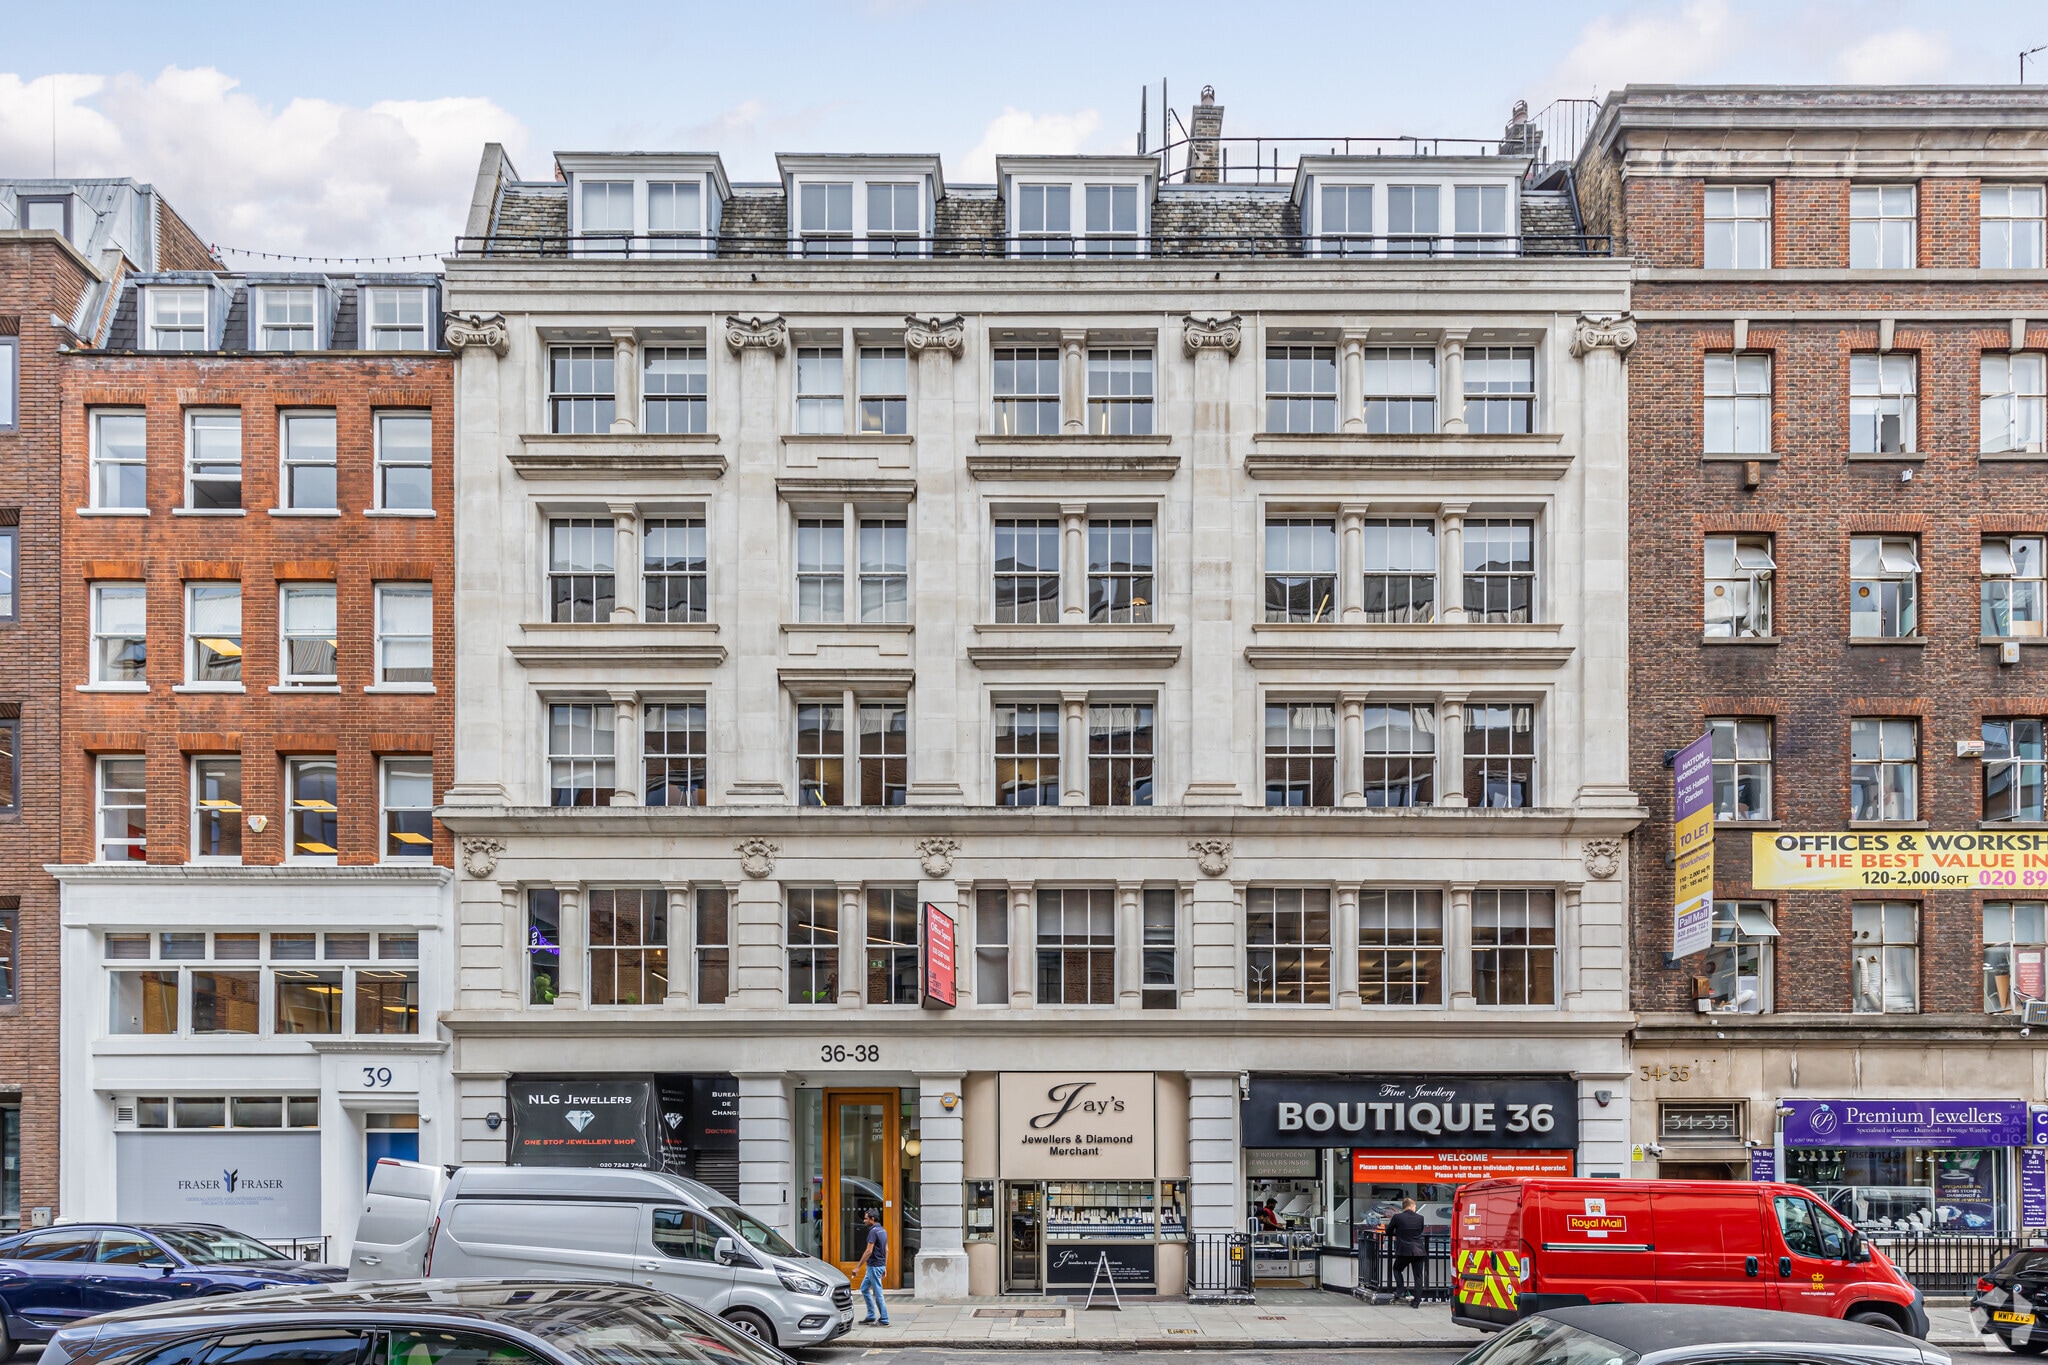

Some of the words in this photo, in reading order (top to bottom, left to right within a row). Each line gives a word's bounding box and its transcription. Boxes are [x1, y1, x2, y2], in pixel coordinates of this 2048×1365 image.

[1677, 756, 1711, 783] WORKSHOPS
[1682, 751, 1704, 771] HATTON
[1692, 774, 1710, 790] Hatton
[1684, 788, 1704, 804] Garden
[1680, 833, 1692, 847] TO
[1694, 822, 1710, 840] LET
[1775, 835, 1889, 851] OFFICES
[1896, 835, 1917, 851] &
[1925, 835, 2048, 850] WORKSH
[1679, 851, 1710, 870] Workshops
[1801, 854, 1853, 868] THE
[1861, 854, 1924, 868] BEST
[1932, 854, 2015, 867] VALUE
[2023, 854, 2048, 867] IN
[1862, 870, 1940, 885] 120-2,000
[1941, 875, 1955, 885] SQ
[1957, 875, 1968, 884] FT
[1979, 870, 2016, 886] 020
[2023, 870, 2047, 886] 89
[1680, 913, 1692, 928] Pall
[1692, 907, 1708, 923] Mall
[821, 1044, 879, 1062] 36-38
[363, 1067, 392, 1087] 39
[1640, 1064, 1690, 1082] 34-35
[528, 1094, 560, 1105] NLG
[1379, 1083, 1405, 1097] Fine
[1408, 1084, 1456, 1102] Jewellery
[1029, 1082, 1125, 1129] Jay's
[1279, 1102, 1496, 1134] BOUTIQUE
[1505, 1104, 1555, 1132] 36
[1670, 1115, 1728, 1129] 34-35
[1846, 1107, 1924, 1123] Premium
[1926, 1107, 2002, 1128] Jewellers
[566, 1138, 612, 1146] JEWELLERY
[1021, 1134, 1071, 1144] Jewellers
[1075, 1134, 1082, 1144] &
[1086, 1134, 1133, 1144] Diamond
[1049, 1146, 1099, 1156] Merchant
[1483, 1164, 1515, 1172] individually
[178, 1180, 220, 1189] FRASER
[241, 1179, 283, 1189] FRASER
[1571, 1218, 1598, 1229] Royal
[1601, 1218, 1622, 1228] Mail
[1053, 1250, 1078, 1268] Jay's
